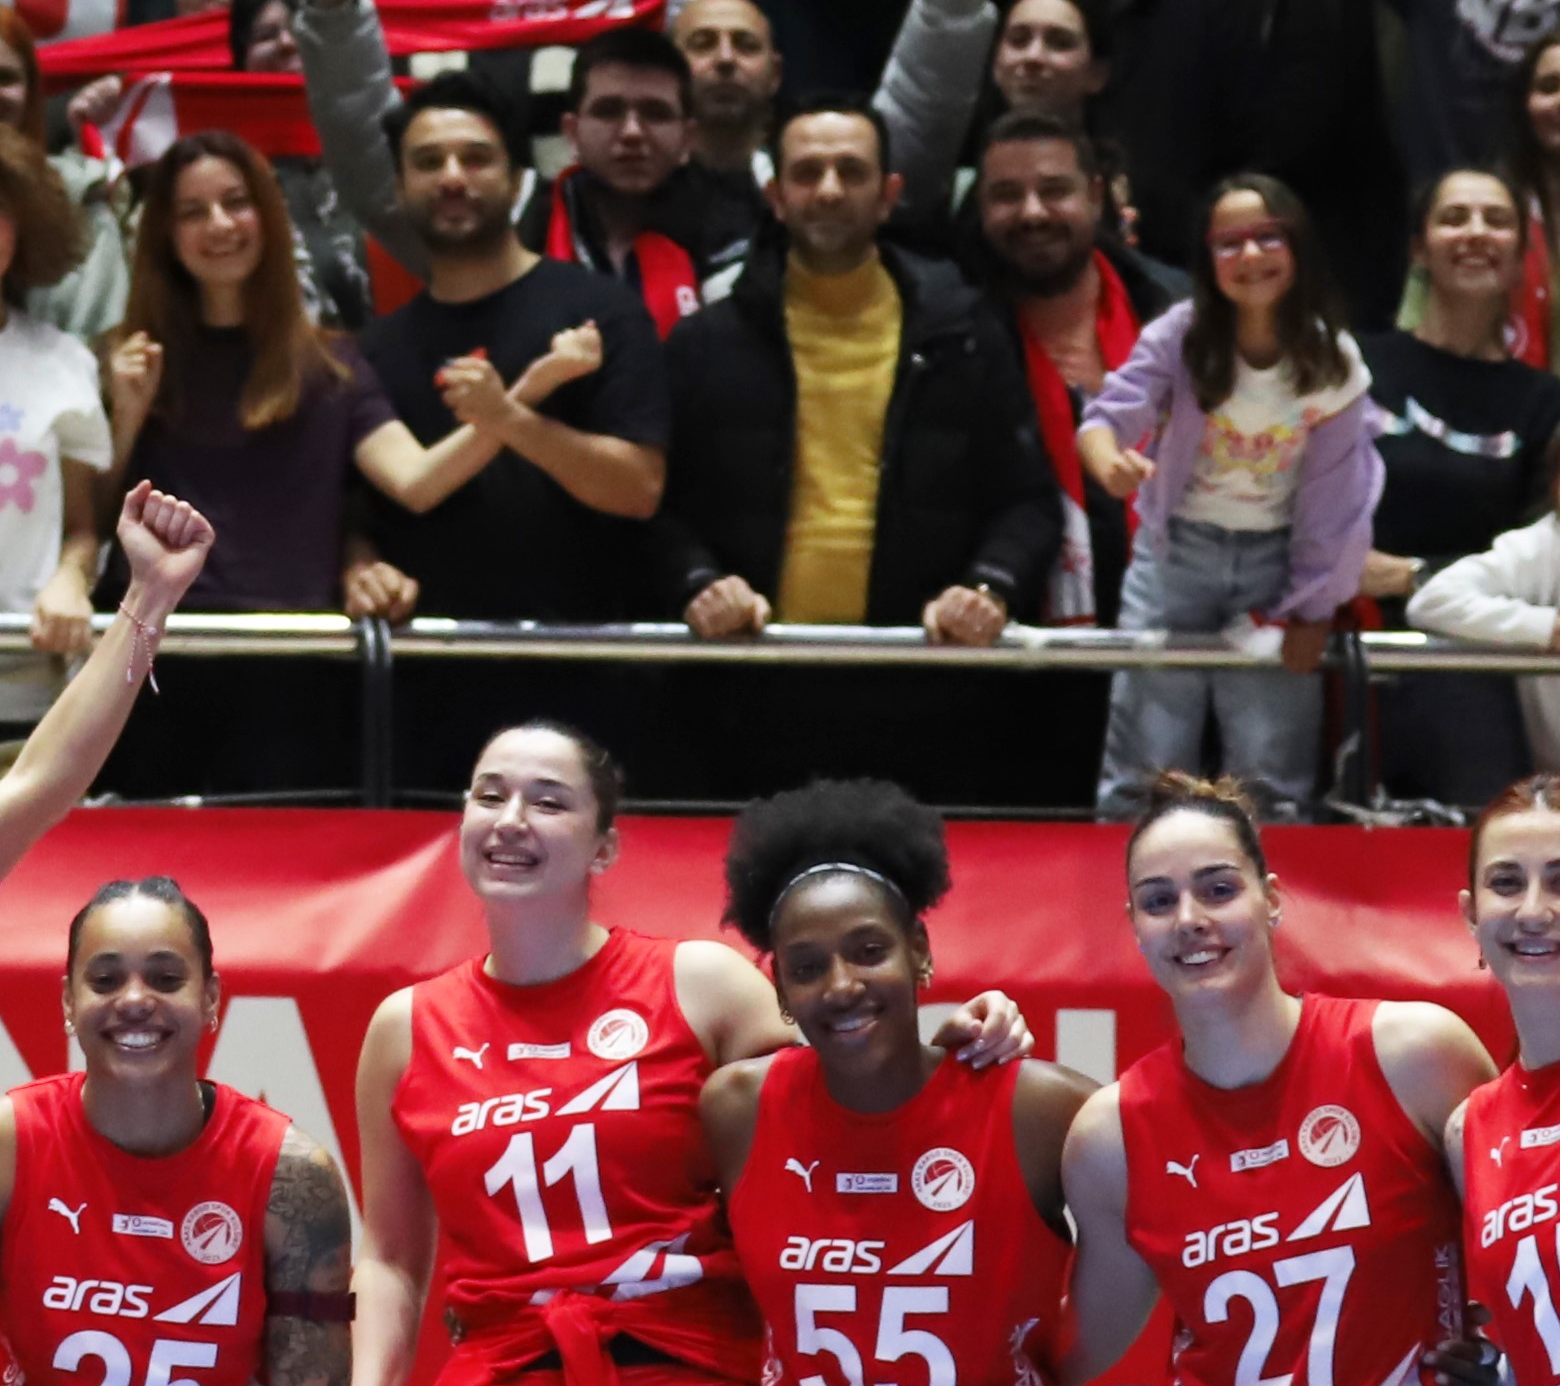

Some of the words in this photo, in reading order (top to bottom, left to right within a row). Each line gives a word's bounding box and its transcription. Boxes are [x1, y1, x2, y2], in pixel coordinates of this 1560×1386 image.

[451, 1087, 553, 1137] aras
[484, 1122, 613, 1263] 11
[1481, 1183, 1559, 1249] aras
[779, 1236, 885, 1275] aras
[1182, 1211, 1281, 1268] aras
[42, 1276, 154, 1318] aras
